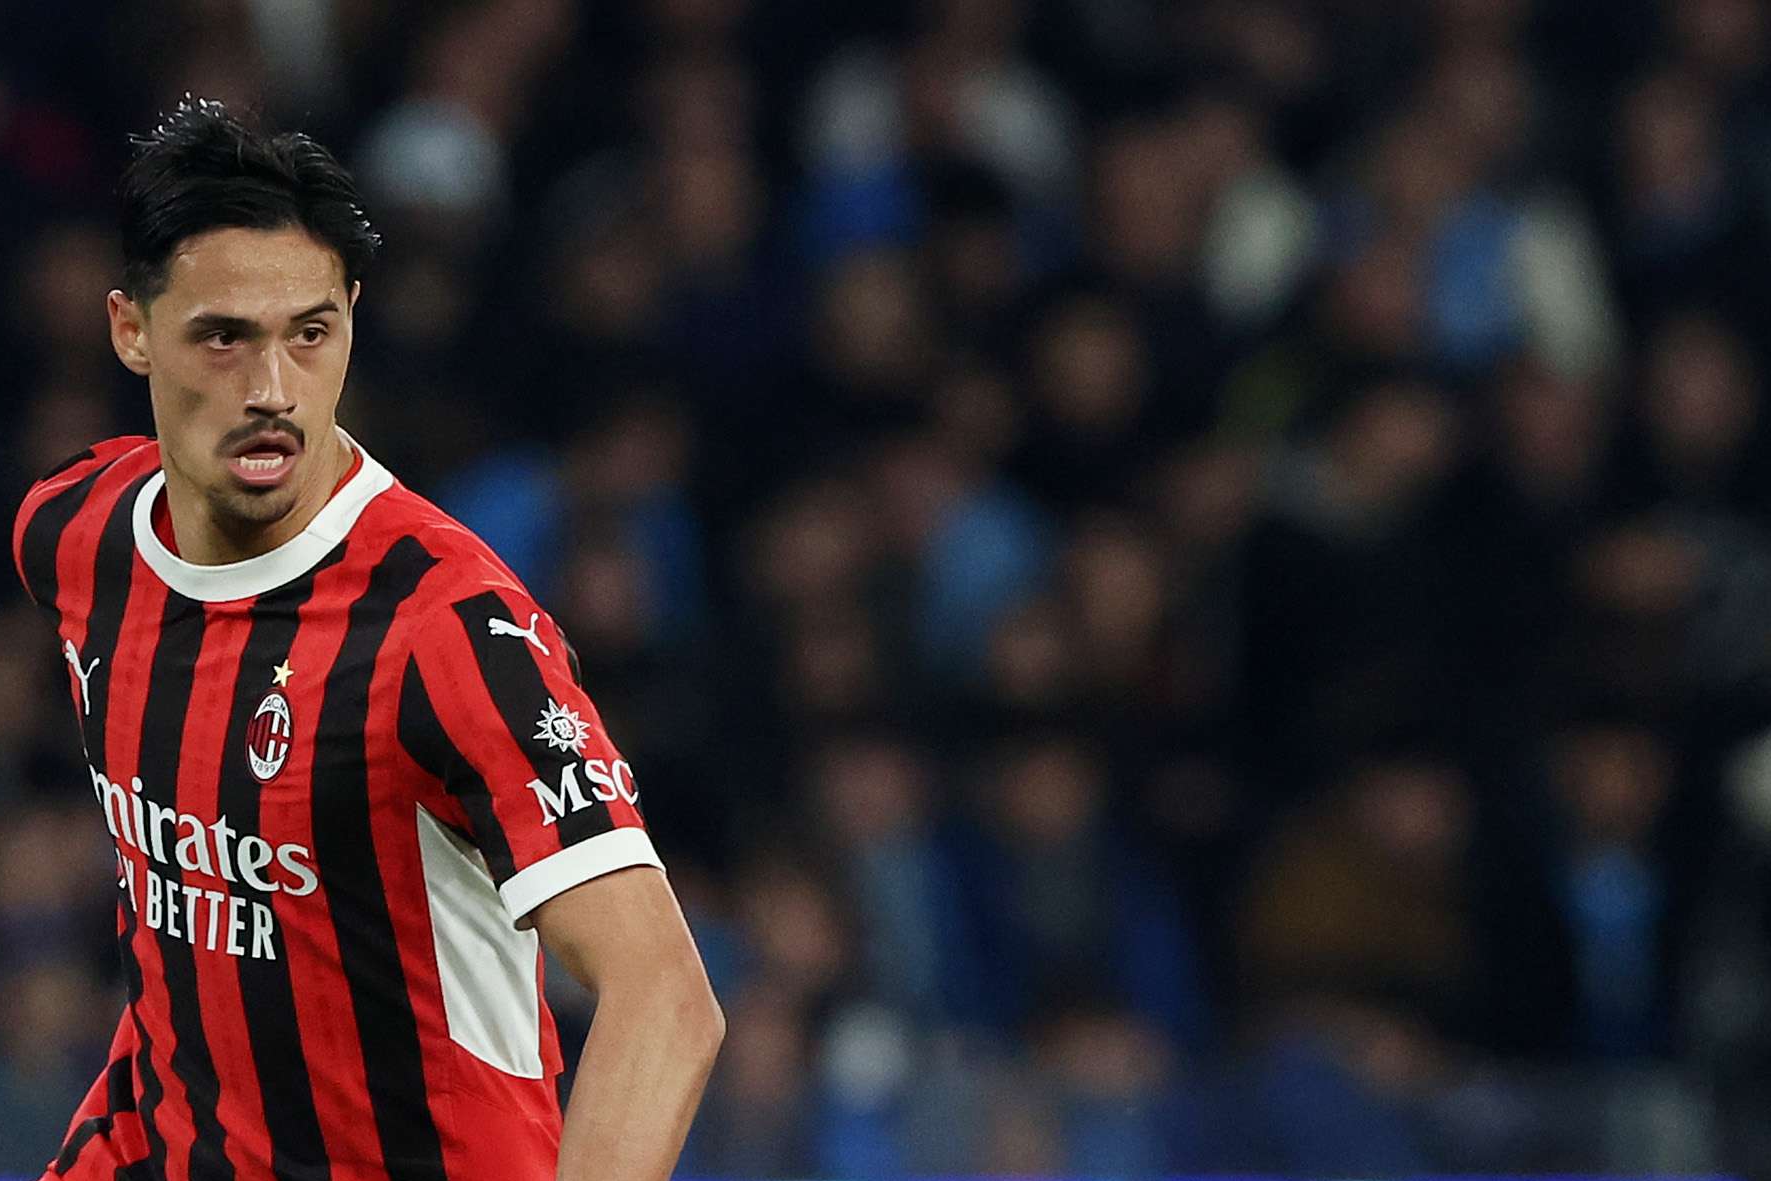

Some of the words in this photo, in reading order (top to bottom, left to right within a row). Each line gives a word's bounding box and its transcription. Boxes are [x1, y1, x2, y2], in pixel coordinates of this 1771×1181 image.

[253, 760, 276, 774] 1899
[525, 758, 639, 826] MSC
[84, 750, 319, 897] mirates
[146, 869, 276, 960] BETTER
